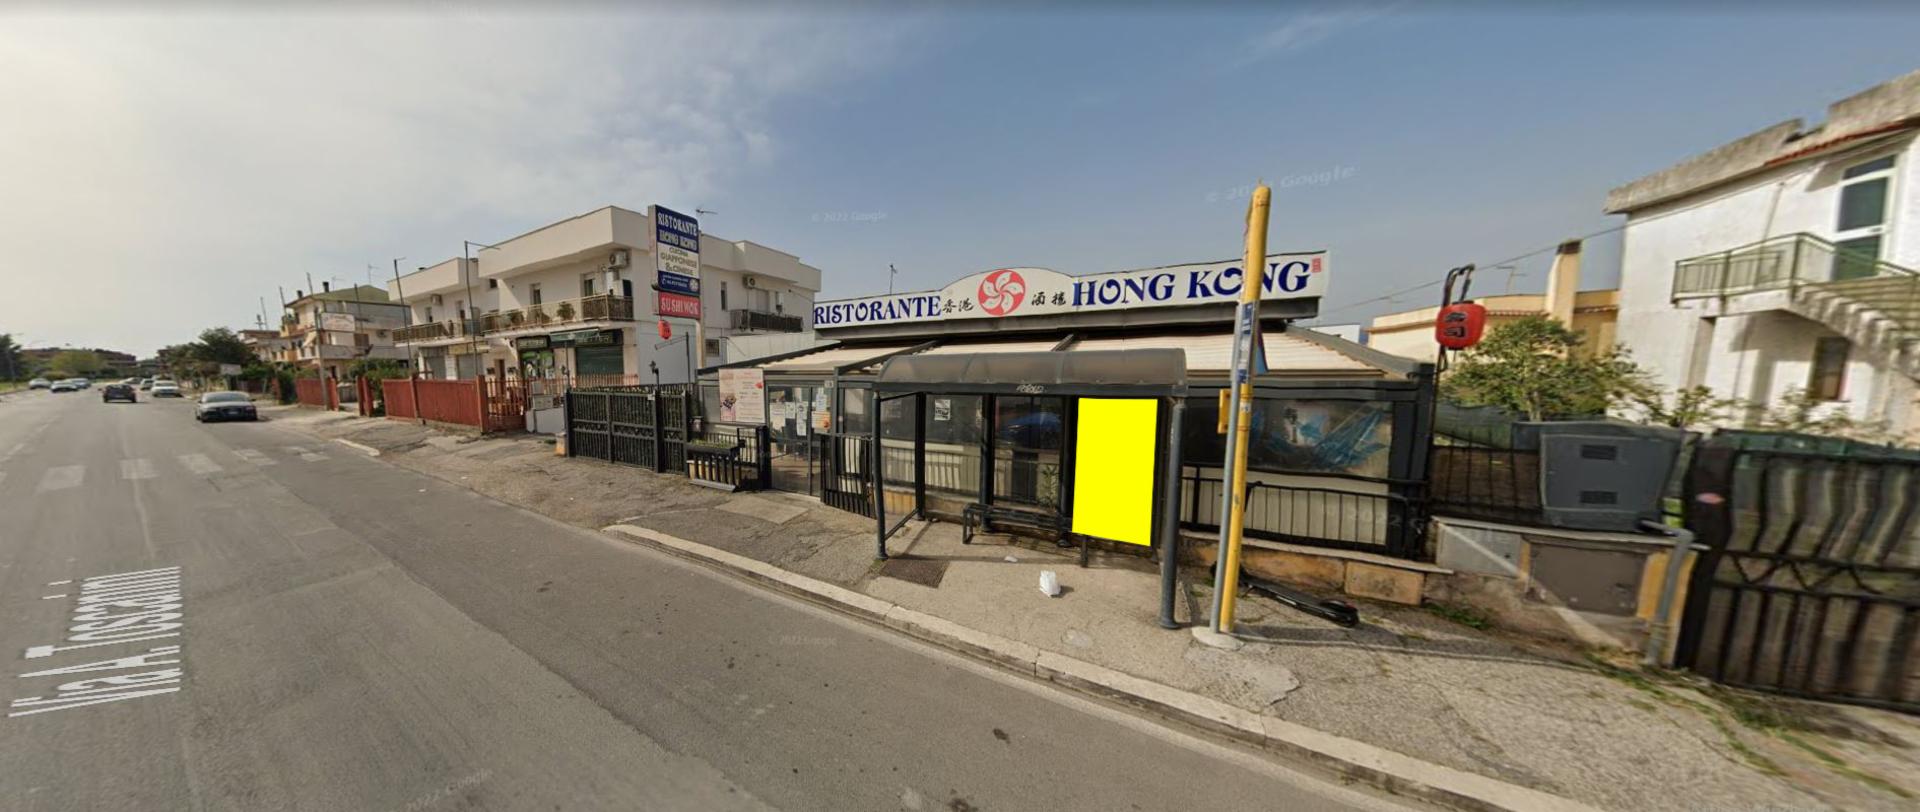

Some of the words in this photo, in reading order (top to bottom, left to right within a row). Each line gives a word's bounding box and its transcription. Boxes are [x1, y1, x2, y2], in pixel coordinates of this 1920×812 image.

[658, 213, 698, 236] RISTORANTE
[1072, 273, 1175, 307] HONG
[1187, 261, 1310, 298] KONG
[814, 296, 941, 325] RISTORANTE
